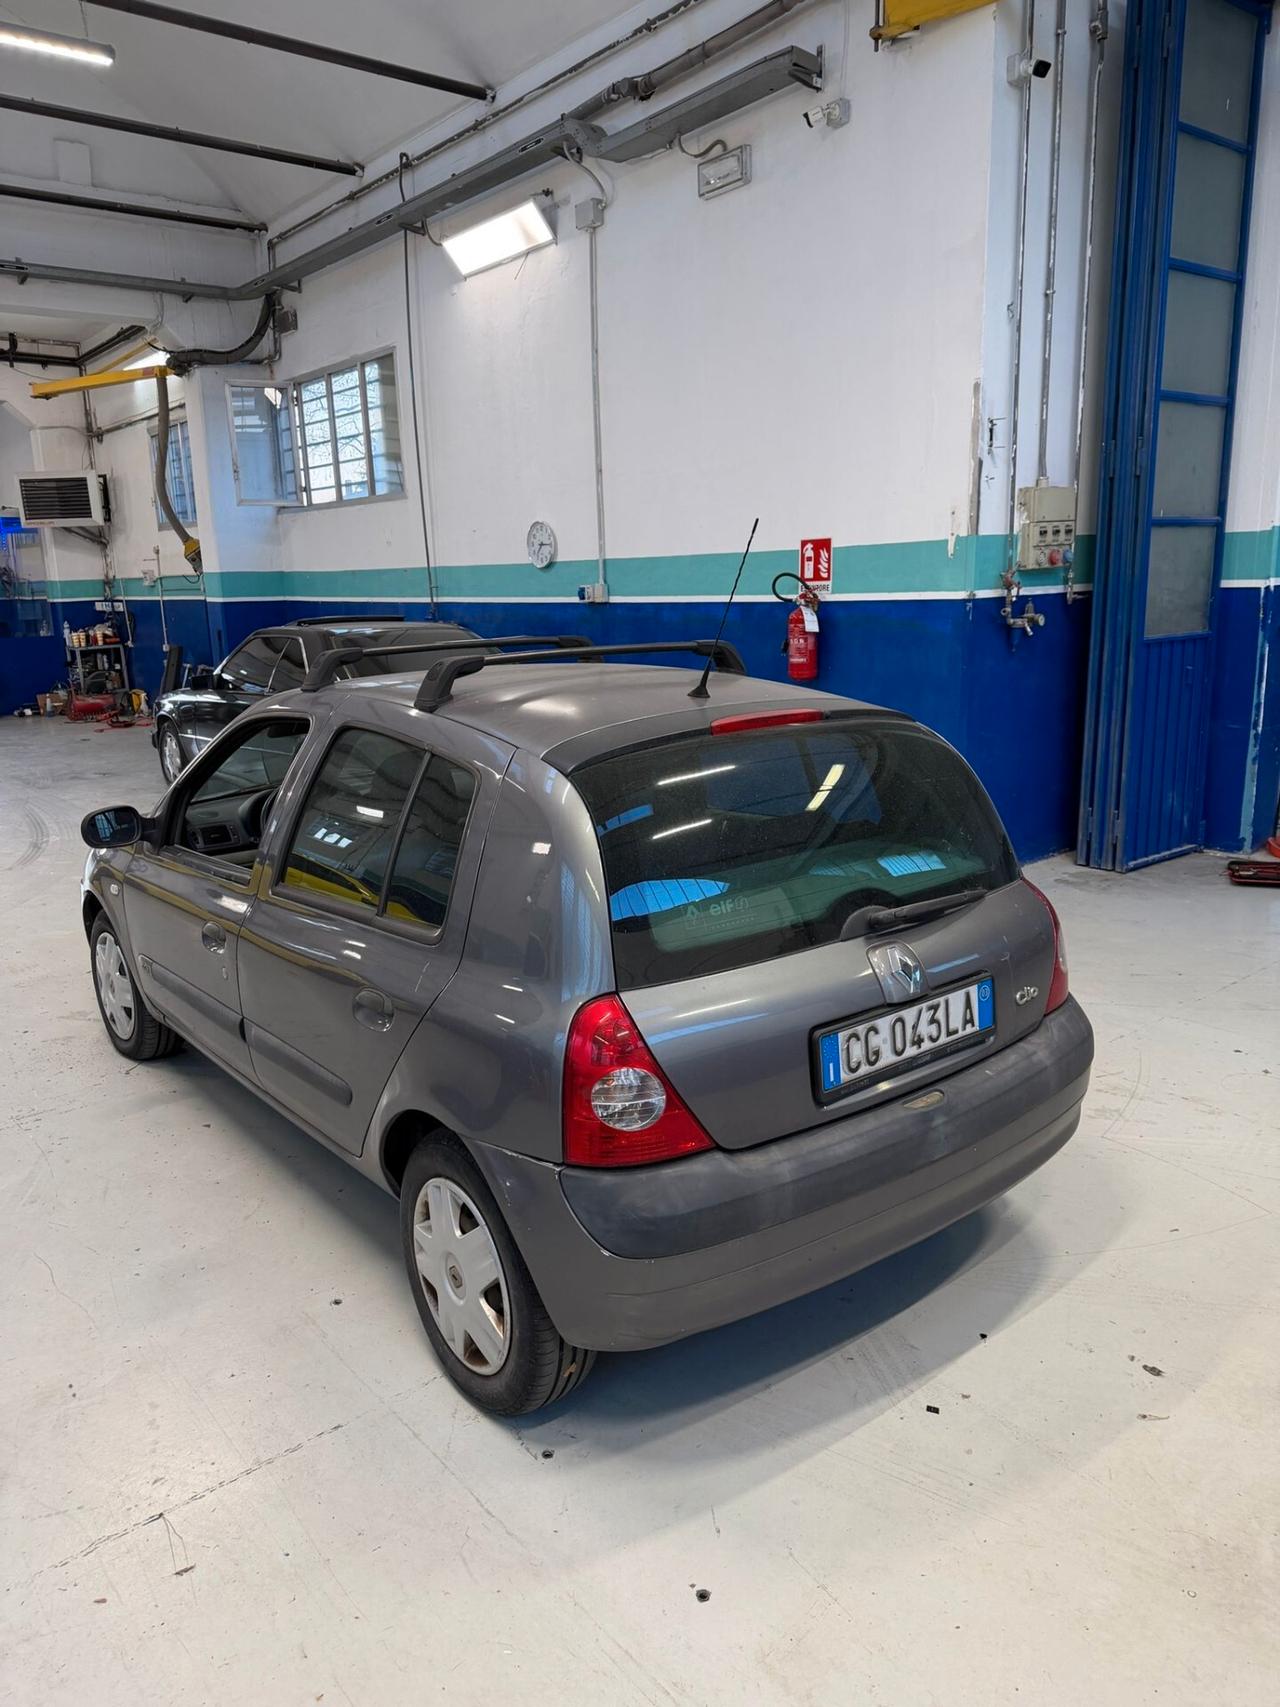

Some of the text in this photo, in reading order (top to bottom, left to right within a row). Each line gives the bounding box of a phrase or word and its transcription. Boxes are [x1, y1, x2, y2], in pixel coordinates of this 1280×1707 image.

[709, 898, 734, 916] elf
[845, 1025, 881, 1074] CG
[891, 991, 976, 1057] 043LA
